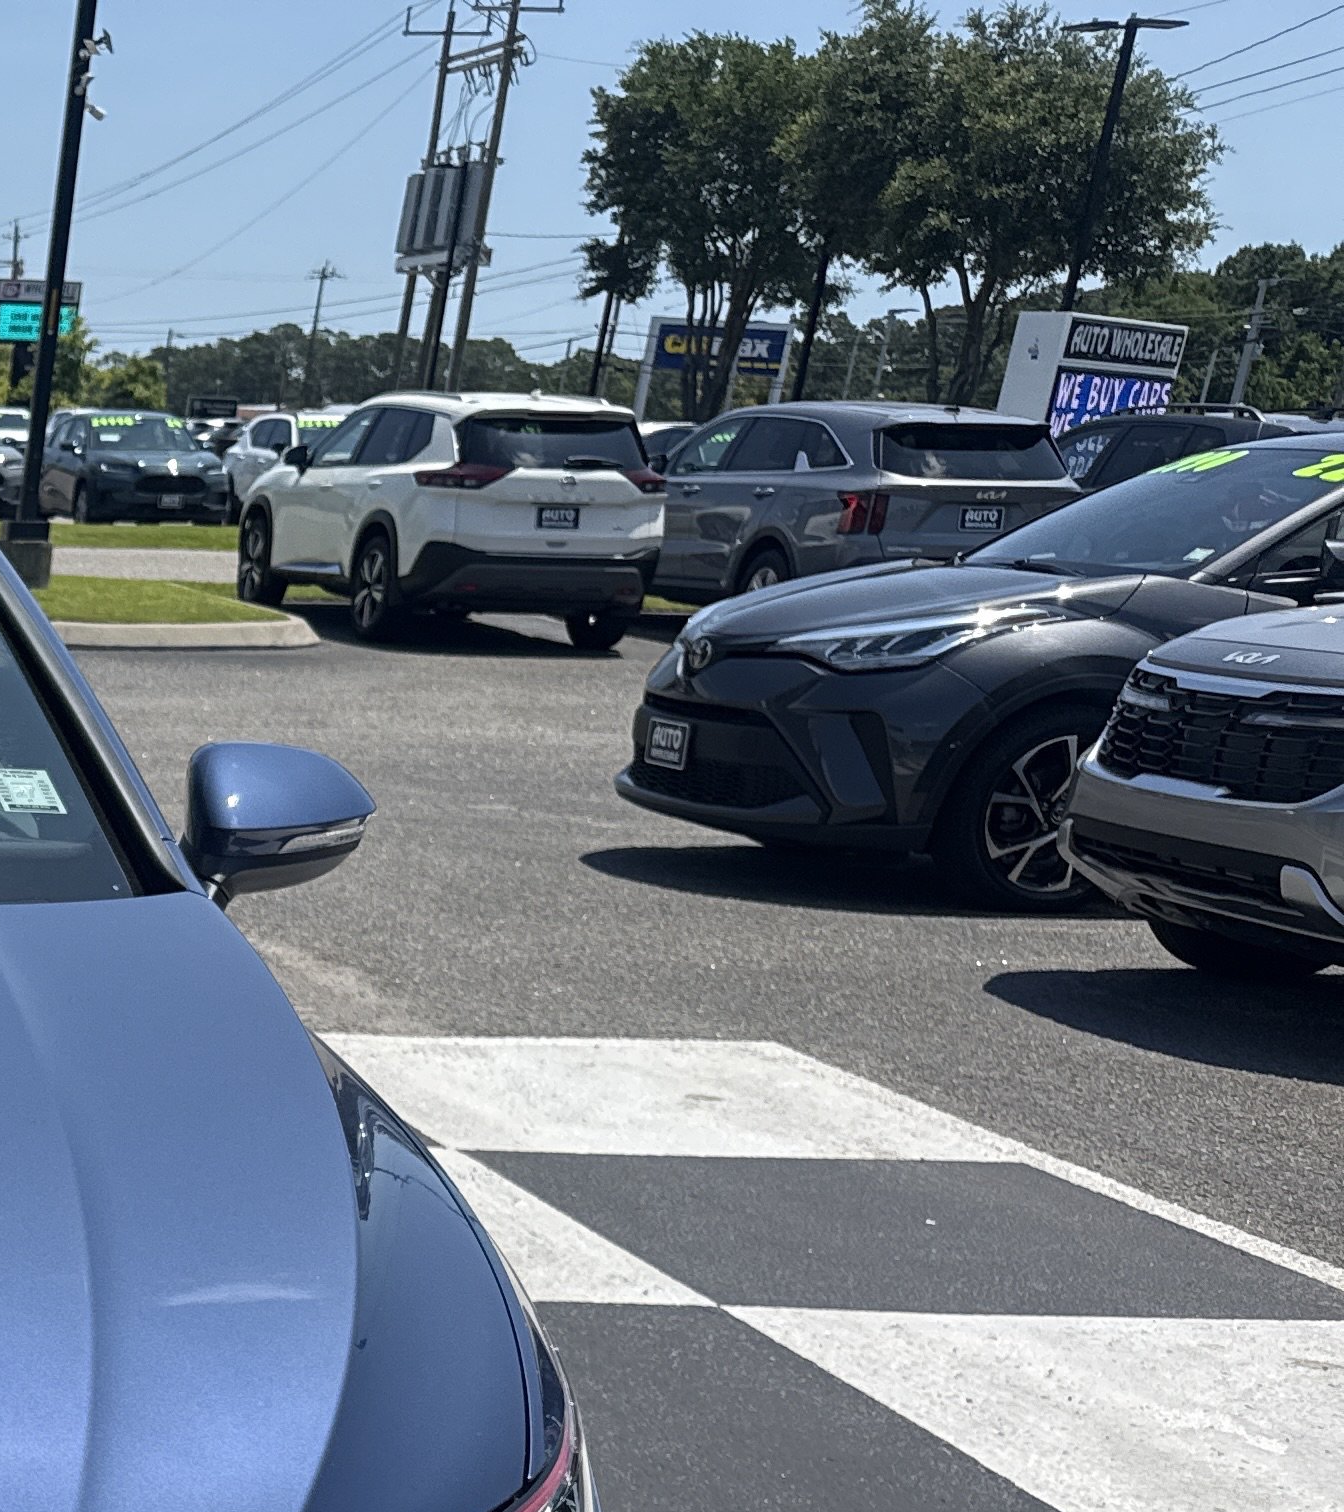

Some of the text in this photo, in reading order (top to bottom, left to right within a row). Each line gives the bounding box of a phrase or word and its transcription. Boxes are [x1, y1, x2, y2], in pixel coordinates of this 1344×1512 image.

[1070, 324, 1183, 364] AUTO WHOLESALE
[1056, 373, 1085, 410] WE
[1086, 376, 1126, 413] BUY
[965, 510, 999, 522] AUTO
[652, 725, 683, 750] AUTO
